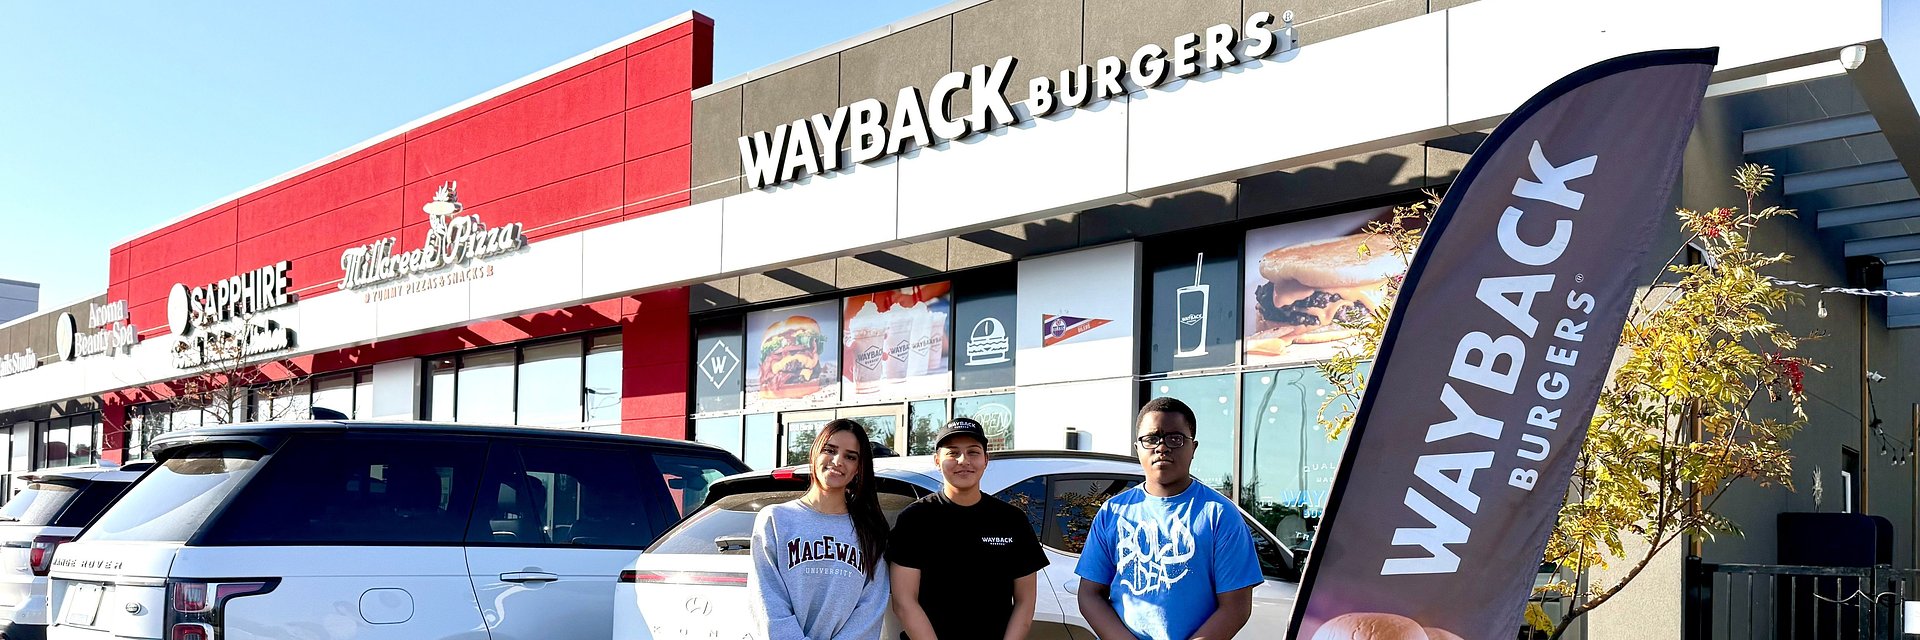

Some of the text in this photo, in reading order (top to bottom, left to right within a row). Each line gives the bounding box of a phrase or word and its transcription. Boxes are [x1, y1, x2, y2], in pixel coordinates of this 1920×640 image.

[738, 12, 1278, 190] WAYBACK BURGERS
[338, 214, 523, 290] Millcreek Pizza
[372, 284, 403, 302] YUMMY
[406, 276, 438, 294] PIZZAS
[447, 265, 485, 286] SNACKS
[89, 300, 126, 328] Aroma
[190, 260, 289, 331] SAPPHIRE
[75, 329, 114, 357] Beauty
[112, 321, 136, 355] Spa
[1381, 140, 1598, 575] WAYBACK
[1508, 289, 1595, 491] BURGERS
[981, 536, 1014, 544] WAYBACK
[1116, 497, 1196, 575] BOLD
[805, 567, 853, 578] UNIVERSITY
